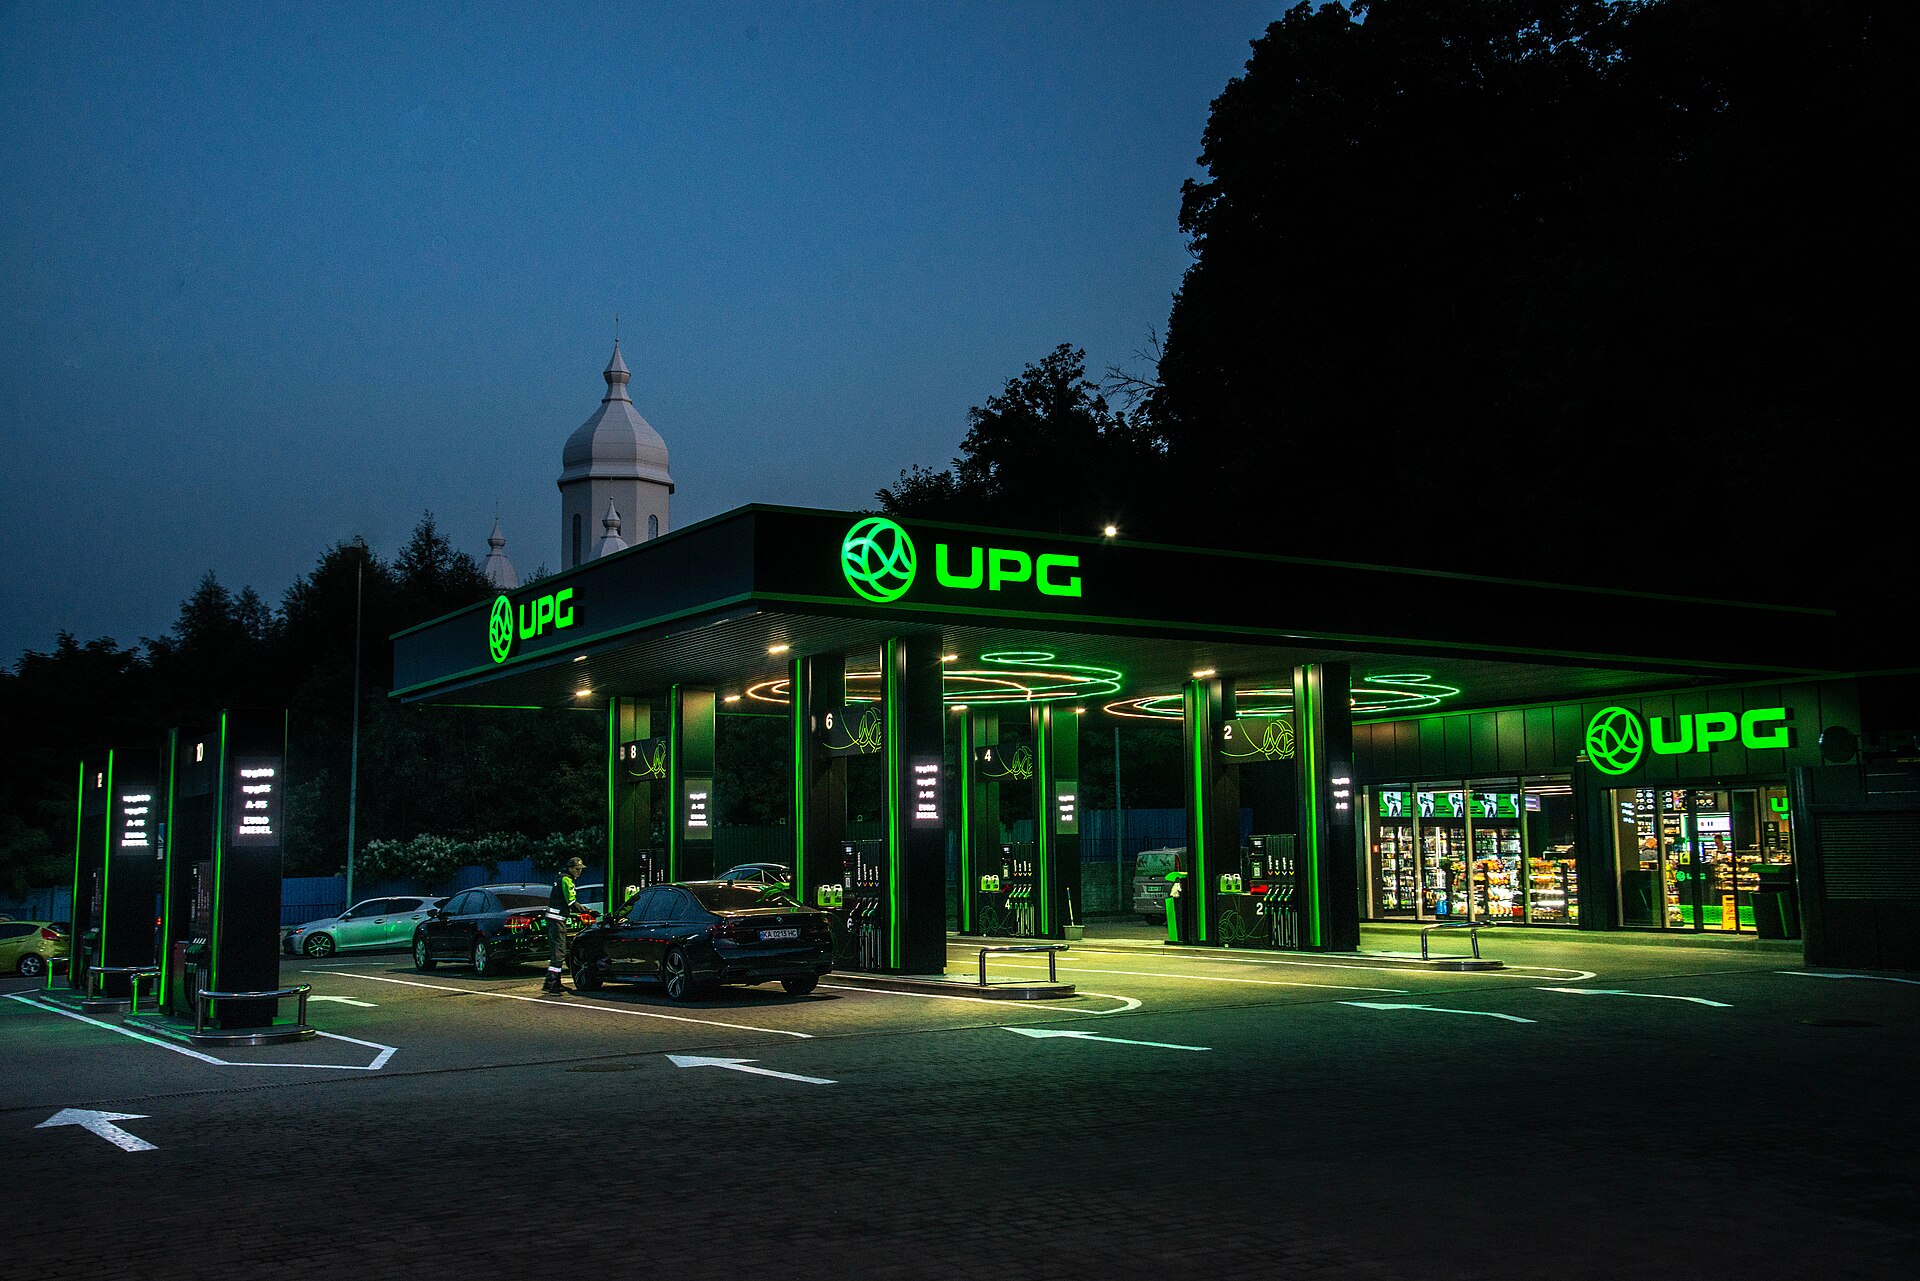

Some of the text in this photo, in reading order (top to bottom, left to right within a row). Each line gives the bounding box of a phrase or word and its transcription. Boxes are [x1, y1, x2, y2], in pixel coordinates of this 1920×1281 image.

[936, 543, 1082, 597] UPG
[519, 587, 574, 640] UPG
[825, 712, 833, 730] 6
[1224, 724, 1233, 740] 2
[1649, 707, 1789, 755] UPG
[630, 744, 637, 759] 8
[984, 749, 992, 762] 4
[1256, 902, 1264, 915] 2
